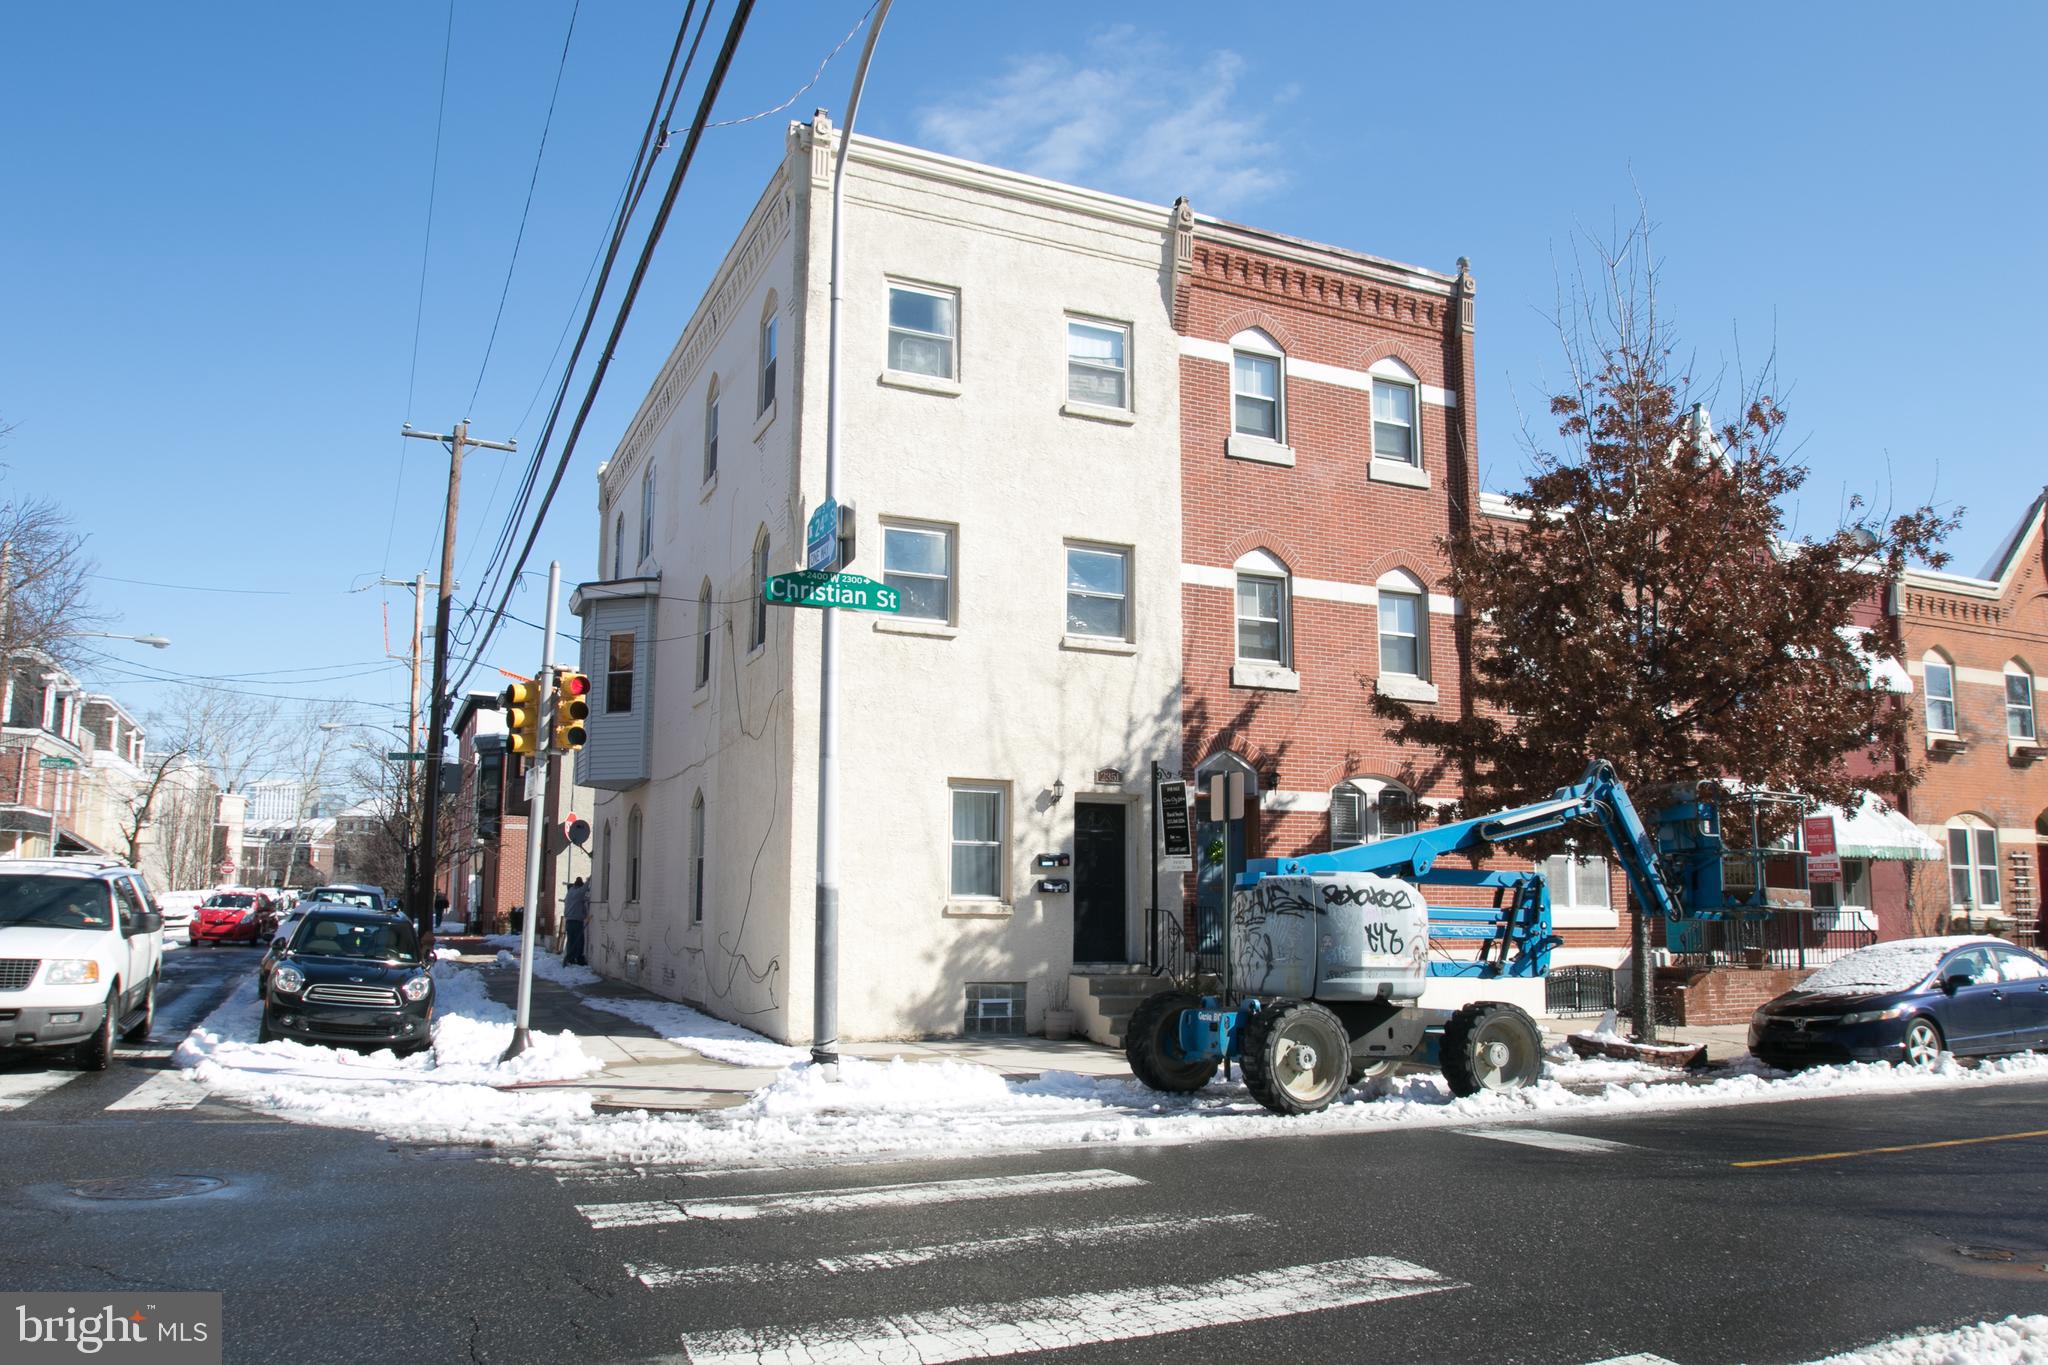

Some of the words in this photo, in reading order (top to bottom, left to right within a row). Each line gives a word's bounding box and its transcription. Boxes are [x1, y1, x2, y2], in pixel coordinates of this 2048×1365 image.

[810, 549, 820, 566] ONE
[806, 571, 829, 580] 2400
[831, 573, 840, 583] W
[842, 575, 863, 584] 2300
[770, 577, 867, 605] Christian
[876, 590, 897, 609] St
